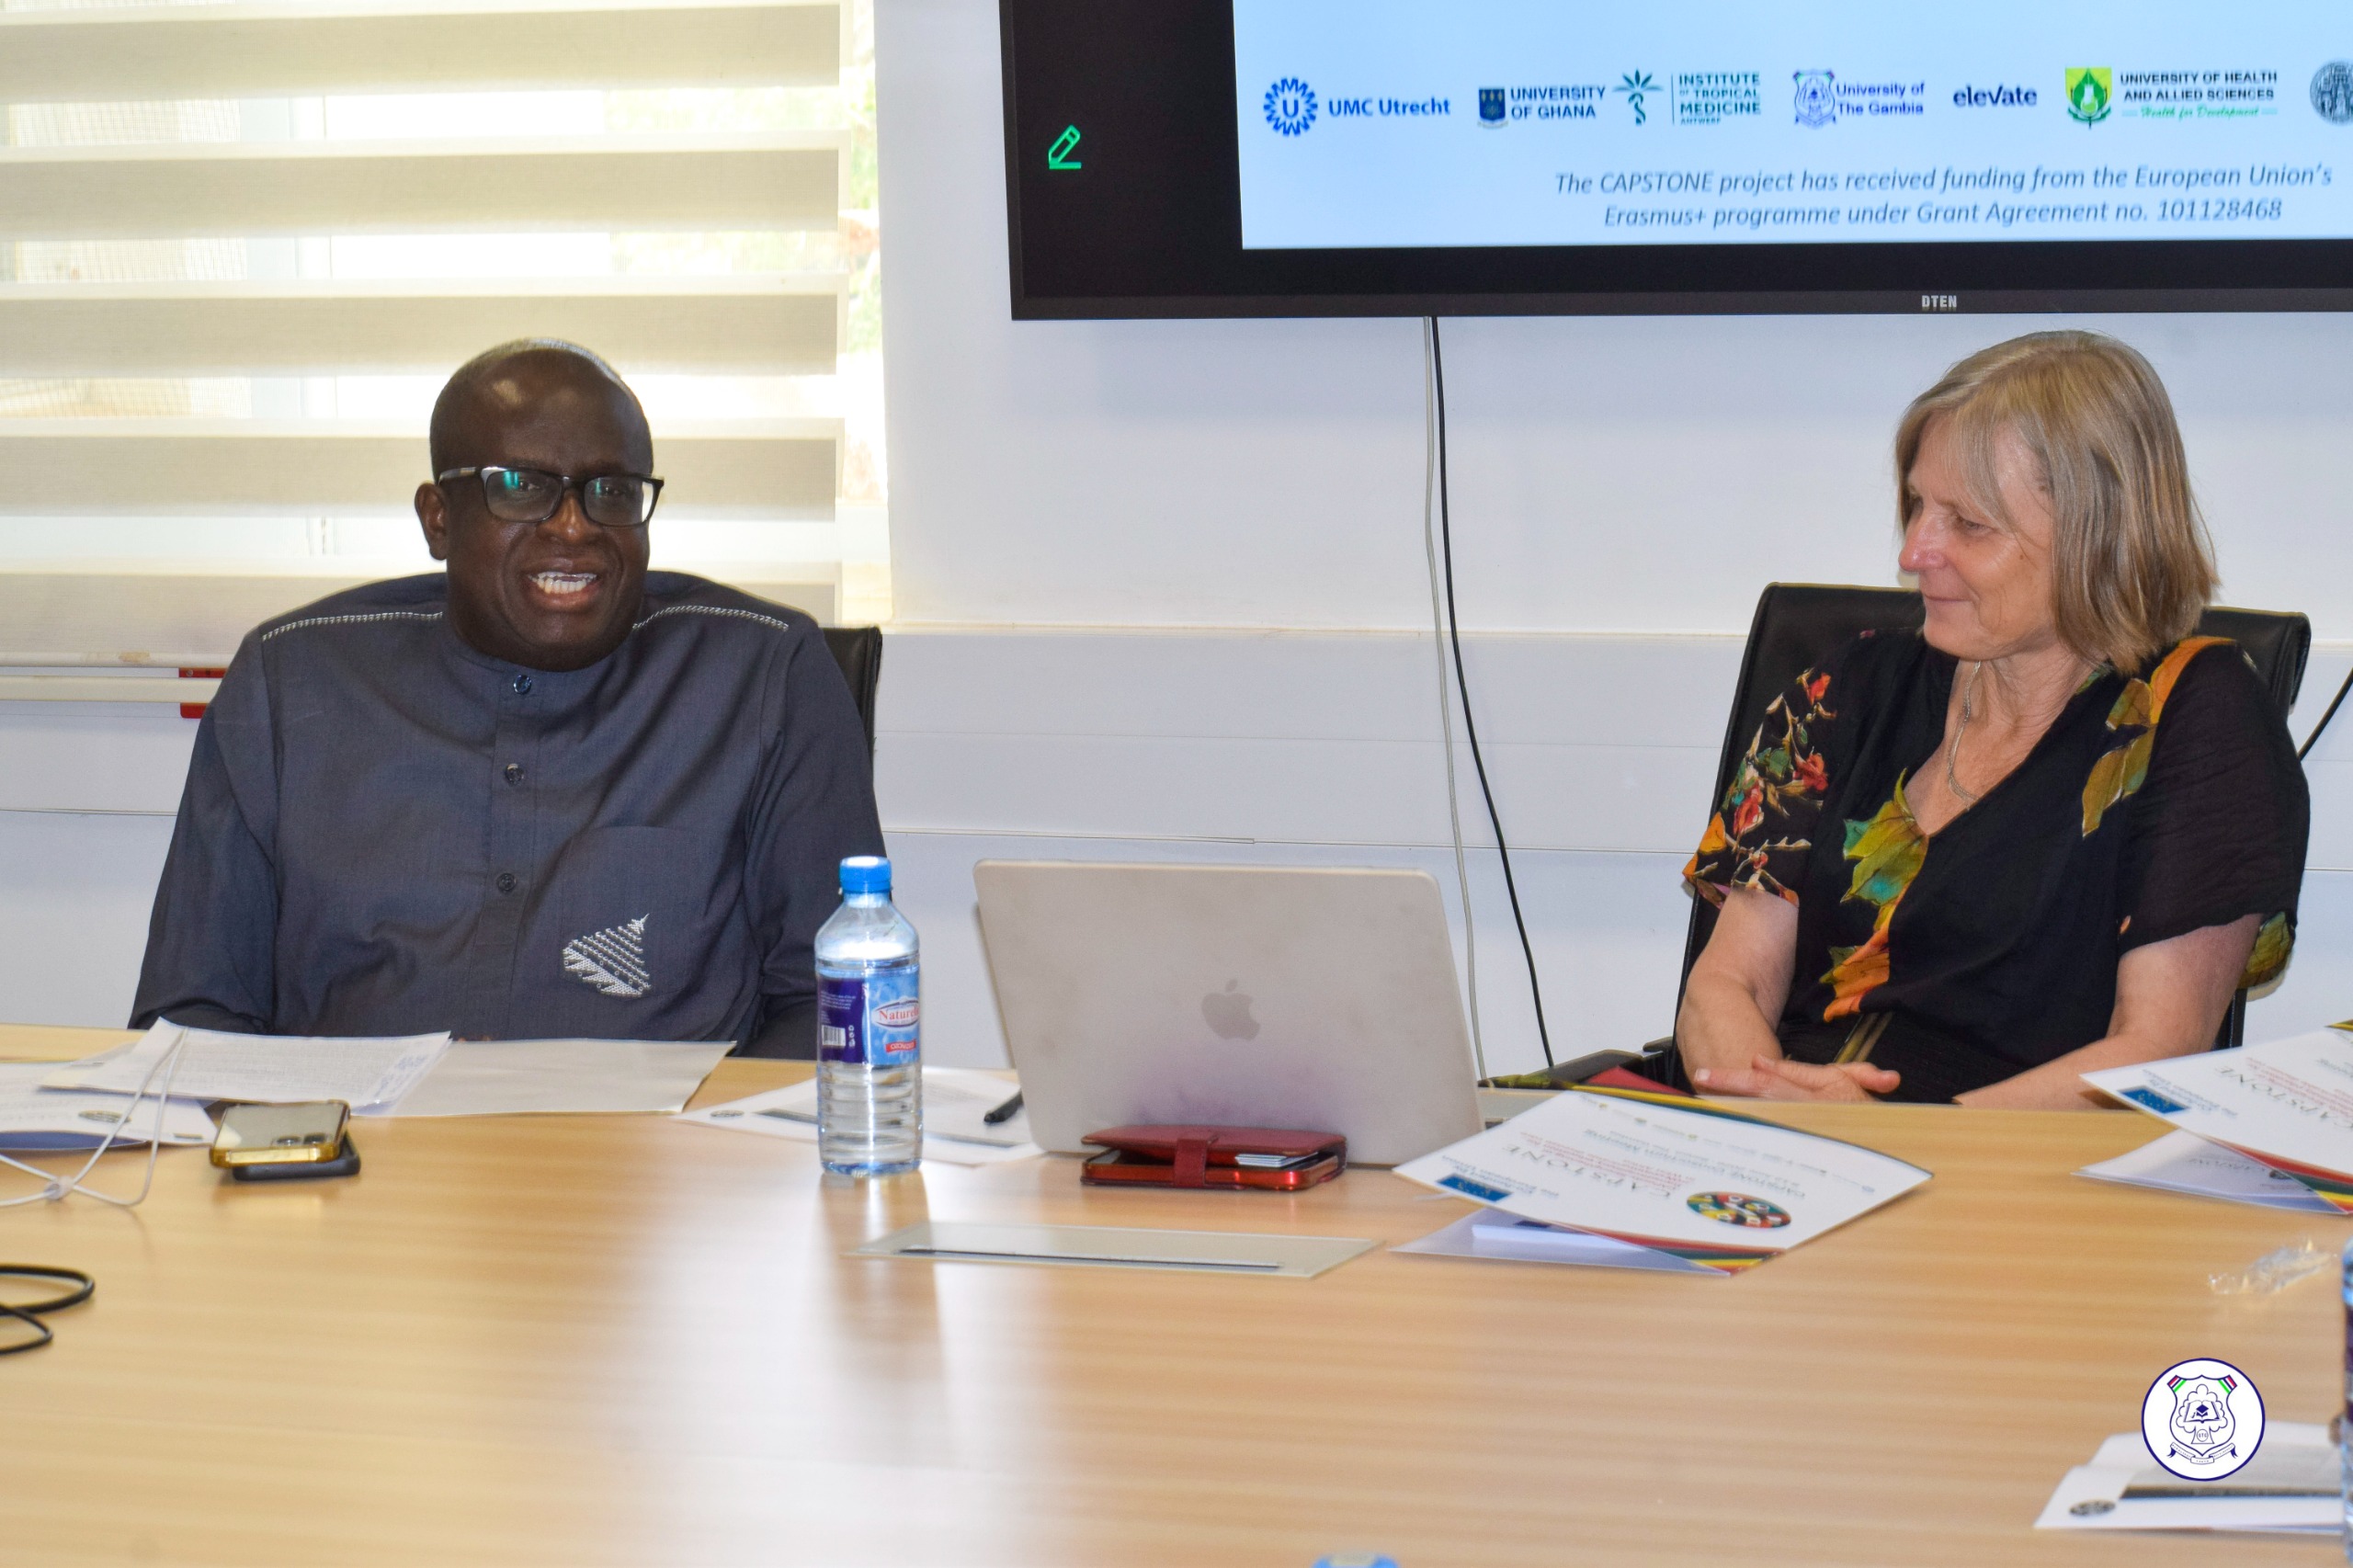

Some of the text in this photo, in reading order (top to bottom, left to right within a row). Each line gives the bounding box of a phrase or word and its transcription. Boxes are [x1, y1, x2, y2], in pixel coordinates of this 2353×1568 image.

[1679, 73, 1760, 85] INSTITUTE
[2120, 71, 2278, 85] UNIVERSITY OF HEALTH
[1511, 85, 1606, 101] UNIVERSITY
[1694, 87, 1760, 99] TROPICAL
[1836, 81, 1925, 97] University of
[2124, 88, 2274, 102] AND ALLIED SCIENCES
[1328, 96, 1451, 117] UMC Utrecht
[1511, 104, 1596, 119] OF GHANA
[1680, 101, 1761, 115] MEDICINE
[1839, 101, 1924, 116] The Gambia
[1556, 172, 1592, 194] The
[1600, 171, 1714, 193] CAPSTONE
[1719, 170, 1794, 197] project
[1802, 170, 1838, 191] has
[1846, 167, 1936, 191] received
[1939, 165, 2025, 194] funding
[2029, 165, 2085, 192] from
[2094, 165, 2127, 187] the
[2135, 165, 2241, 191] European
[1604, 198, 2282, 230] Erasmus+ programme under Grant Agreement no. 101128468
[1921, 295, 1958, 308] DTEN
